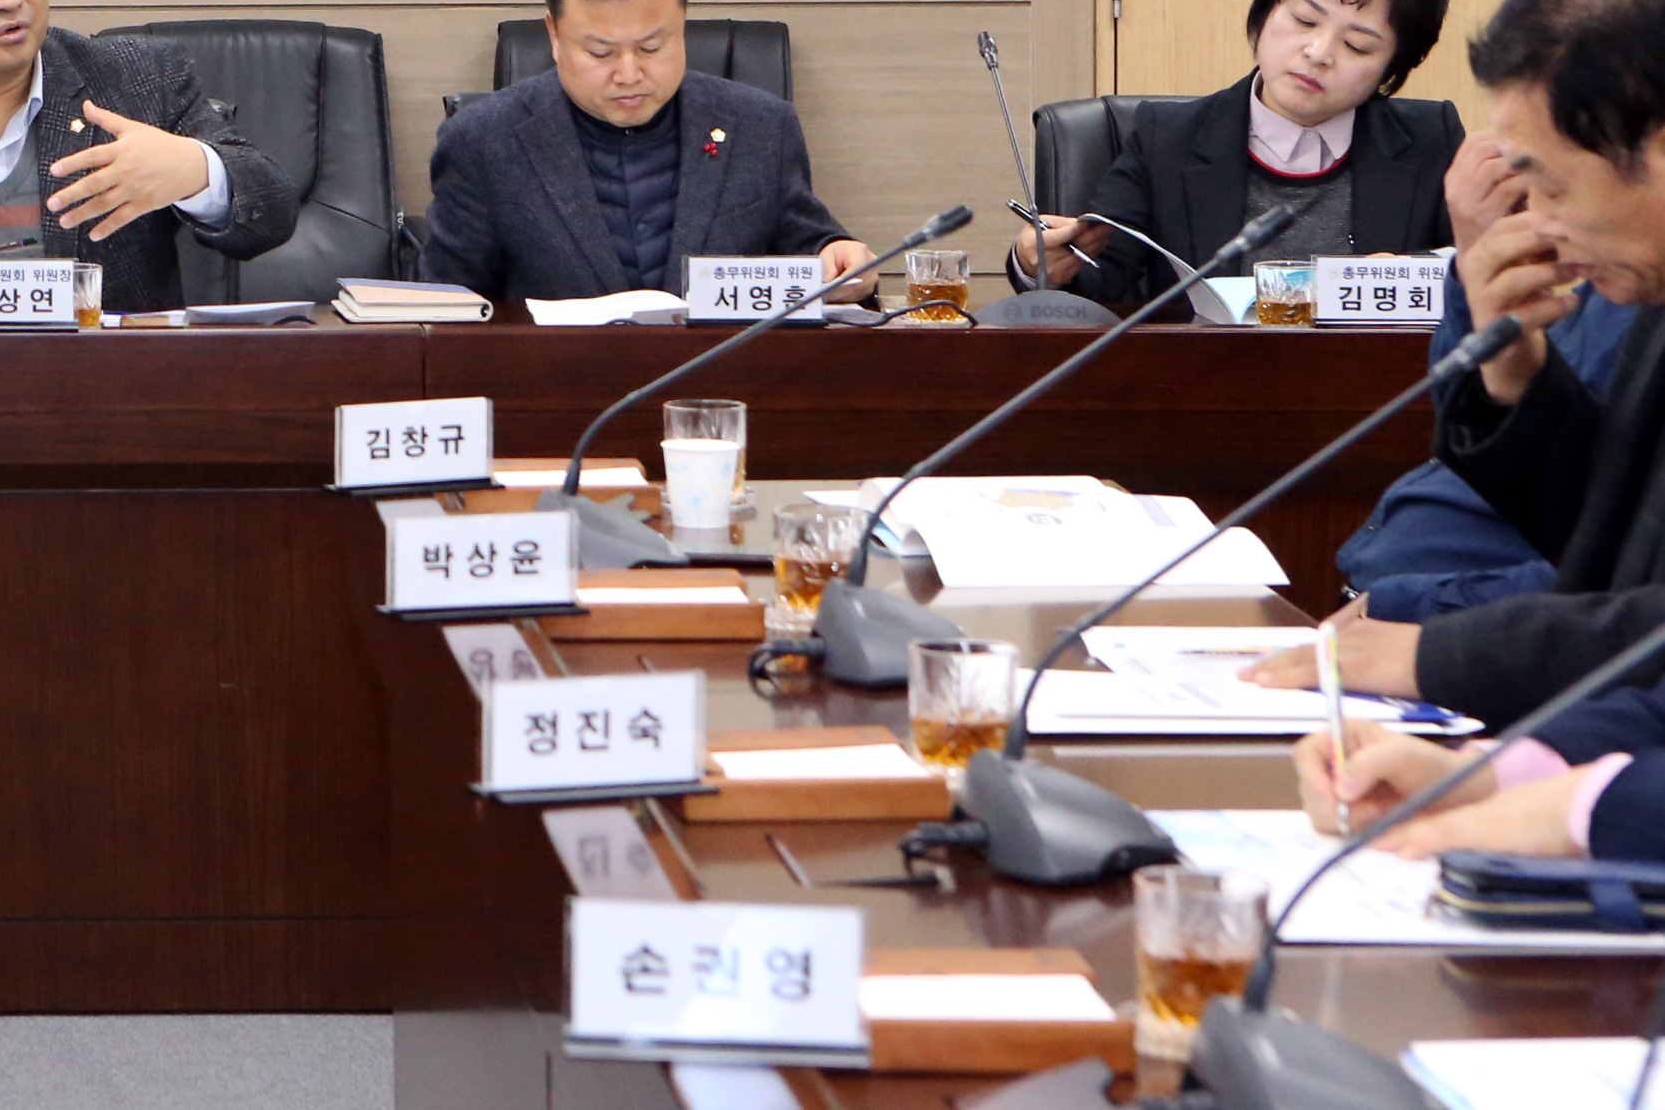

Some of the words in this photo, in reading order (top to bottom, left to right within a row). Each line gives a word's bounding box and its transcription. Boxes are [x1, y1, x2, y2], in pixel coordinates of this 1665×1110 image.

[33, 269, 72, 283] 위원장
[713, 266, 780, 280] 총무위원회
[787, 266, 813, 280] 위원
[1342, 266, 1411, 280] 총무위원회
[1338, 286, 1432, 312] 김명회
[1030, 305, 1087, 319] BOSCH
[365, 423, 467, 461] 김창규
[421, 539, 543, 579] 박상윤
[524, 707, 666, 757] 정진숙
